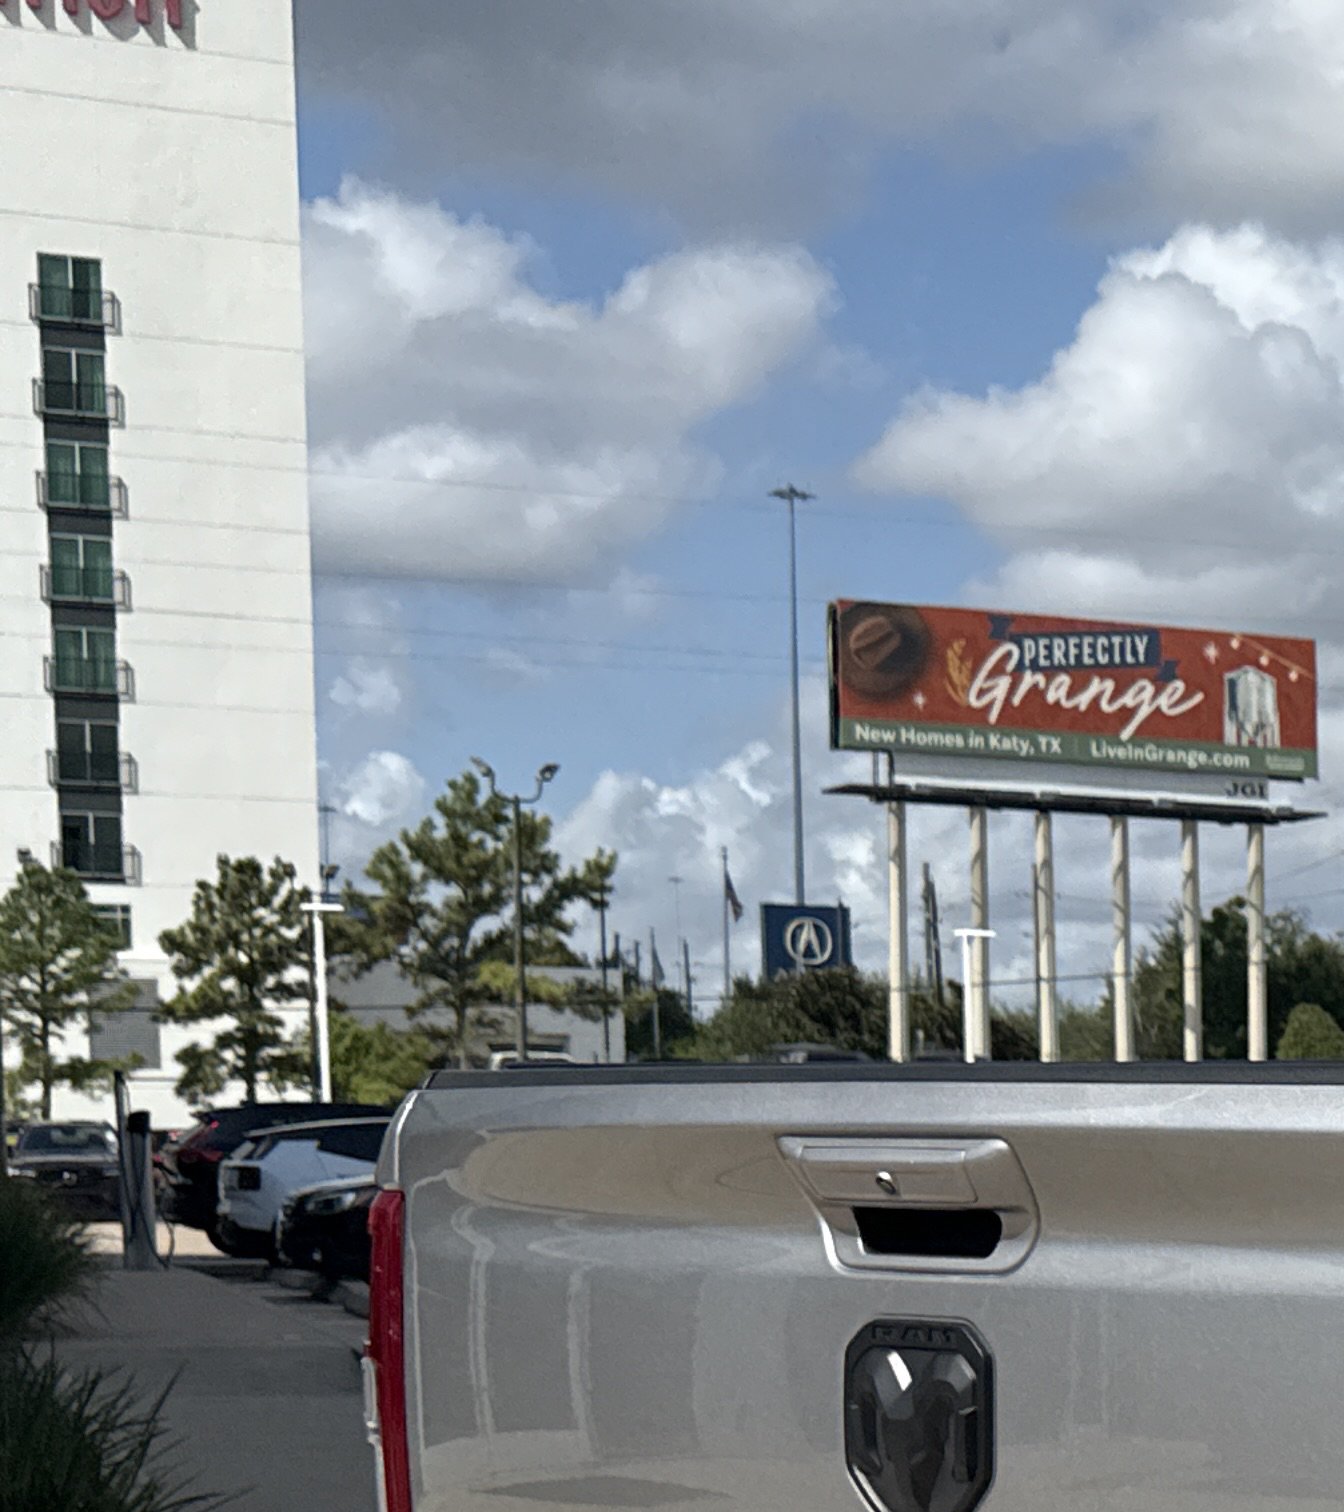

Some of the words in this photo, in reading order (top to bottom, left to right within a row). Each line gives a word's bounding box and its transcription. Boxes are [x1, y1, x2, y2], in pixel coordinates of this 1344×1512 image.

[1023, 634, 1149, 668] PERFECTLY
[968, 642, 1205, 741] Grange
[854, 722, 896, 743] New
[900, 726, 964, 747] Homes
[969, 729, 985, 747] in
[989, 733, 1035, 757] Katy,
[1038, 734, 1062, 754] TX
[1089, 740, 1251, 769] LiveInGrange.com
[871, 1325, 954, 1342] RAM
